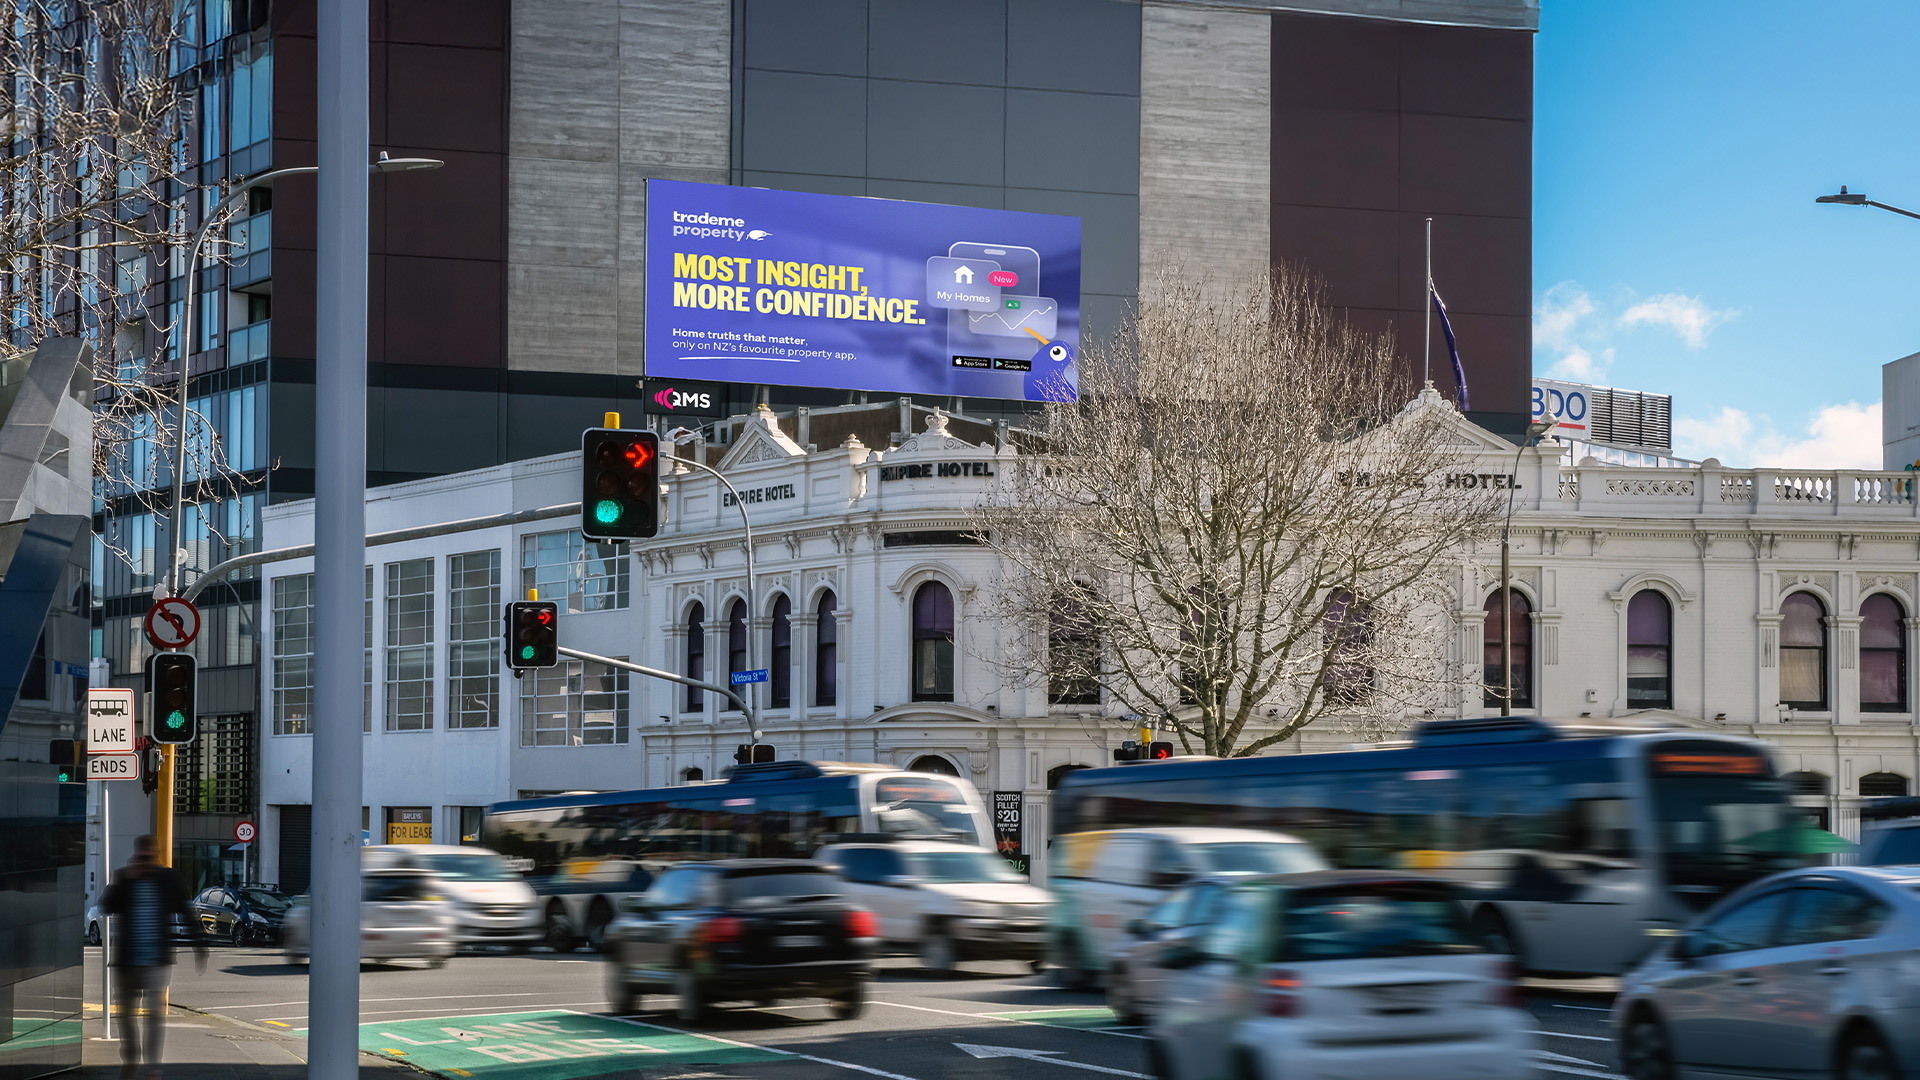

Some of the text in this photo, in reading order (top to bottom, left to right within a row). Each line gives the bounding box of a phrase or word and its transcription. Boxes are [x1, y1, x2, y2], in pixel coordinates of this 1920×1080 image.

[673, 211, 745, 228] trademe
[673, 225, 745, 242] property
[674, 252, 868, 296] MOST INSIGHT,
[993, 274, 1013, 284] New
[673, 281, 926, 324] MORE CONFIDENCE.
[937, 291, 991, 304] My Homes
[672, 328, 808, 346] Home truths that matter,
[672, 340, 695, 351] only
[713, 342, 737, 352] NZ's
[739, 344, 786, 356] favourite
[787, 347, 832, 359] property
[834, 352, 857, 361] app.
[662, 387, 711, 409] QMS
[1532, 386, 1586, 420] BDO
[938, 462, 994, 477] HOTEL
[1446, 473, 1522, 489] HOTEL
[723, 484, 796, 507] EMPIRE HOTEL
[734, 672, 752, 683] Victoria
[753, 671, 759, 681] St
[93, 728, 126, 742] LANE
[91, 760, 127, 773] ENDS
[997, 810, 1019, 822] $20
[239, 828, 252, 836] 30
[391, 826, 407, 838] FOR
[379, 1020, 605, 1046] LANE
[467, 1039, 671, 1063] BUS
